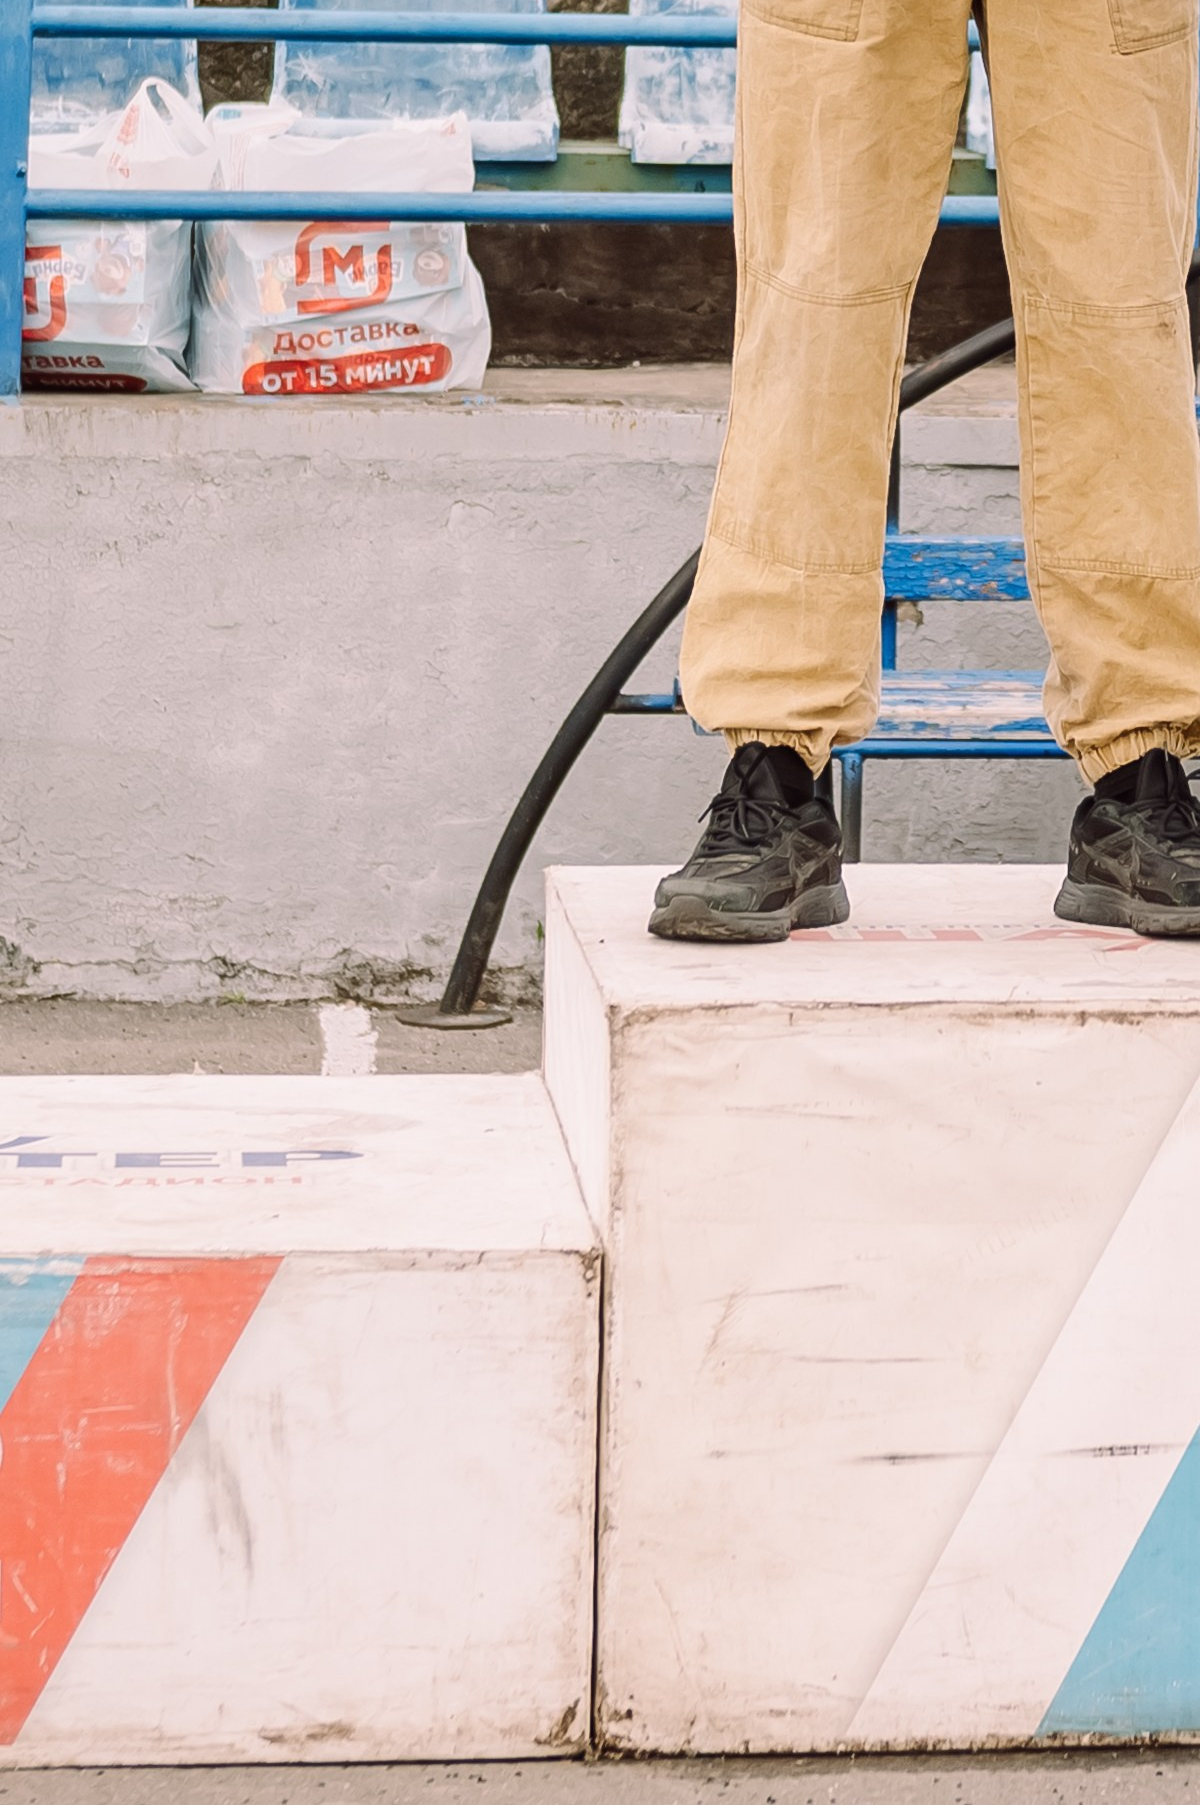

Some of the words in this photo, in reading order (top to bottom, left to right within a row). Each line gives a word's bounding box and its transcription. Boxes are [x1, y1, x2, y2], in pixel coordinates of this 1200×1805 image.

[273, 322, 421, 355] Доставка
[262, 372, 298, 393] от
[305, 364, 338, 389] 15
[345, 354, 436, 386] минут
[0, 1136, 365, 1168] ТЕР
